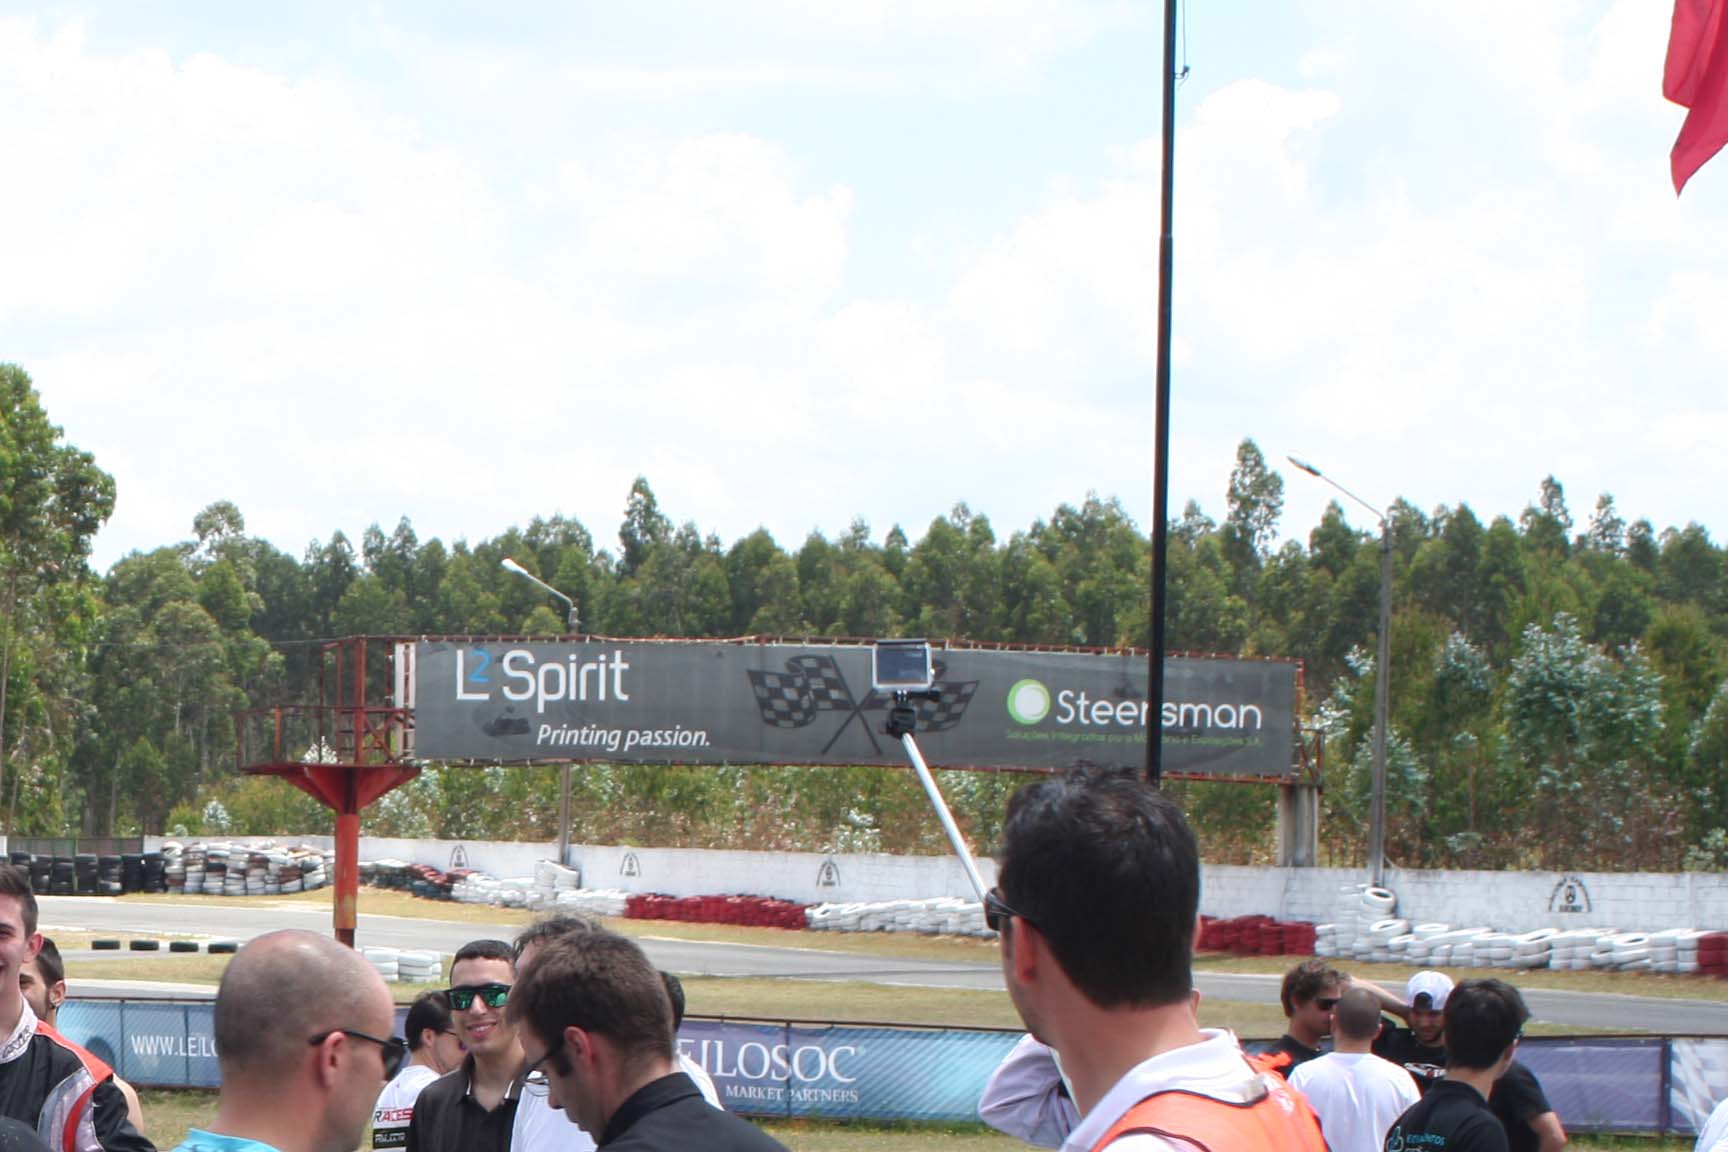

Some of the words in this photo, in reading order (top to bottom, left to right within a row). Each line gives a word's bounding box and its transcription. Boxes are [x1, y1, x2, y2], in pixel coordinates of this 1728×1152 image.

[502, 650, 630, 714] Spirit
[1056, 690, 1262, 729] Steersman
[536, 724, 622, 751] Printing
[624, 725, 711, 751] passion.
[726, 1084, 784, 1099] MARKET
